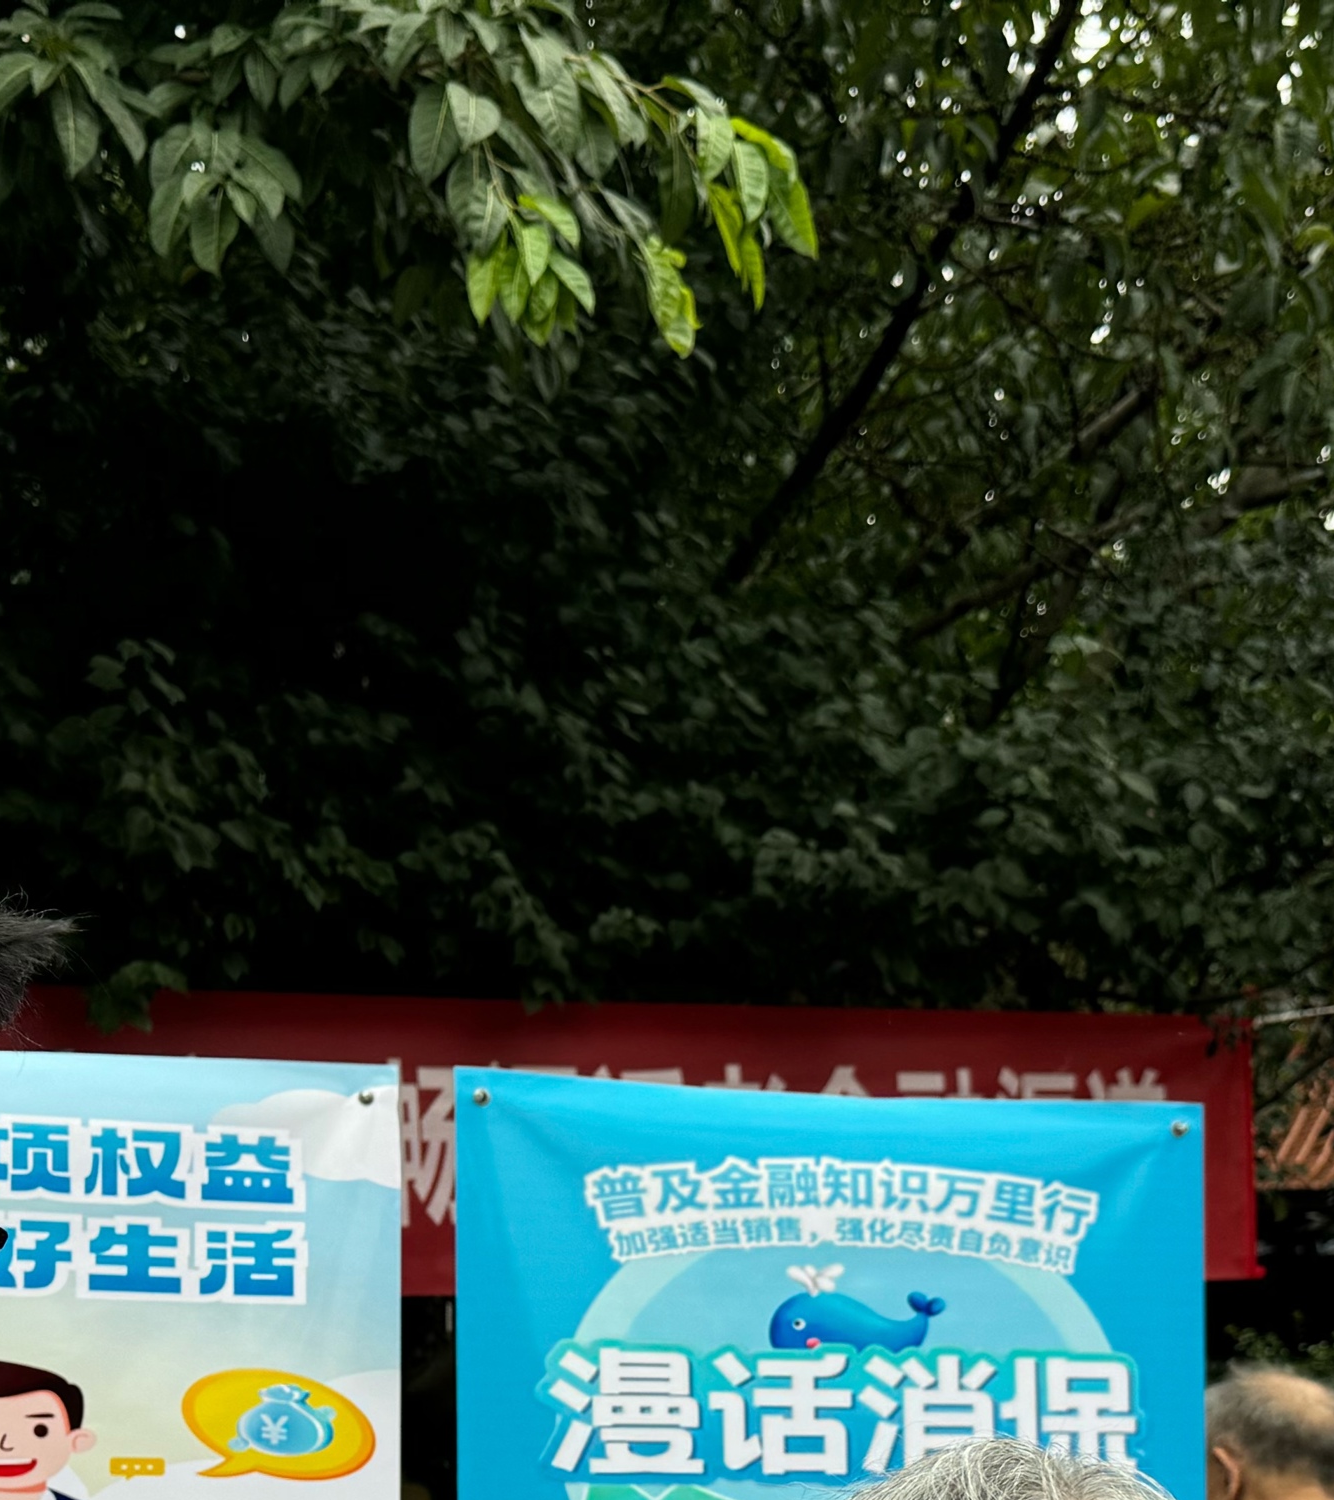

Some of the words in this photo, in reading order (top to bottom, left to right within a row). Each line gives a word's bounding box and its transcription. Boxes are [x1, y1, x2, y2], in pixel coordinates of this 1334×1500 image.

[591, 1162, 1094, 1236] 普及金融知识万里行
[547, 1346, 1139, 1476] 漫话消保
